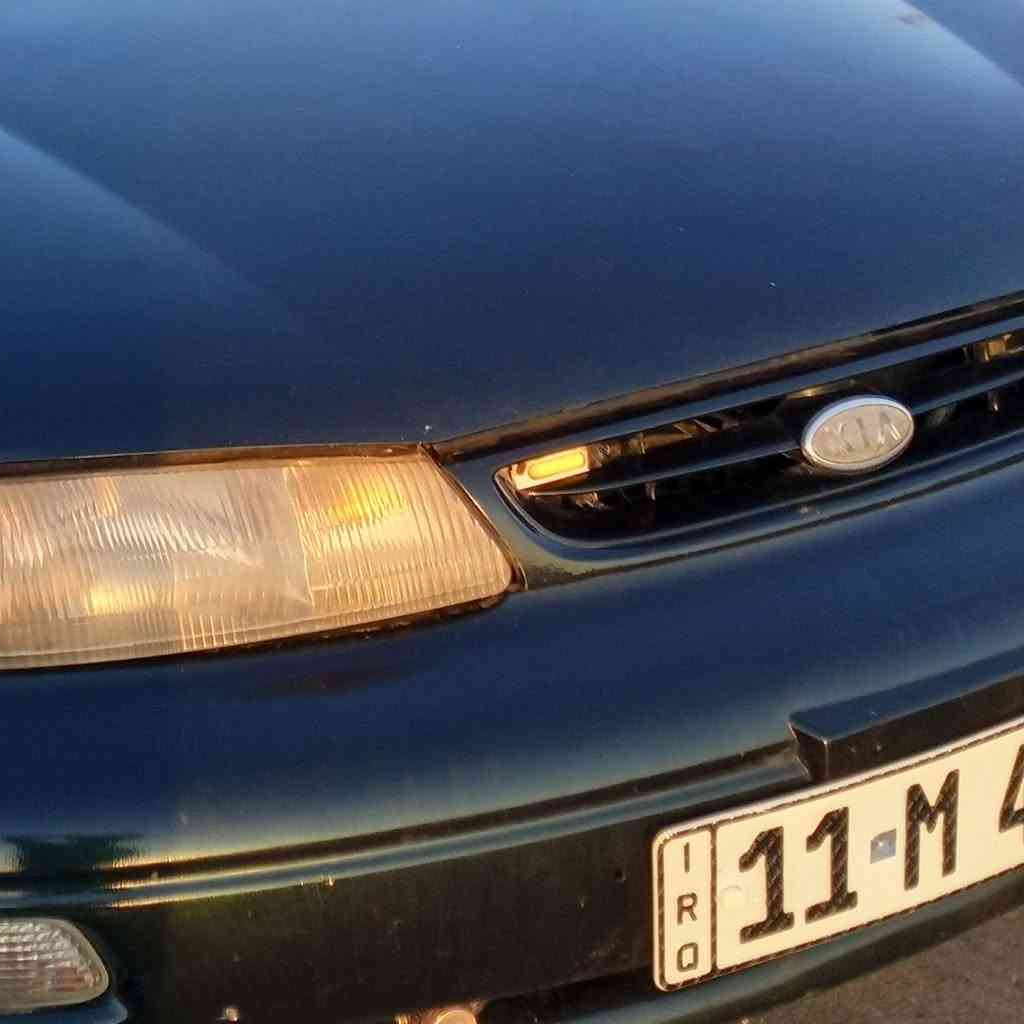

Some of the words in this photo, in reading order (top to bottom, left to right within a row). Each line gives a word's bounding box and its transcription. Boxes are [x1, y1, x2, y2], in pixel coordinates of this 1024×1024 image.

[676, 841, 699, 973] IRQ
[738, 805, 858, 945] 11
[903, 768, 960, 892] M
